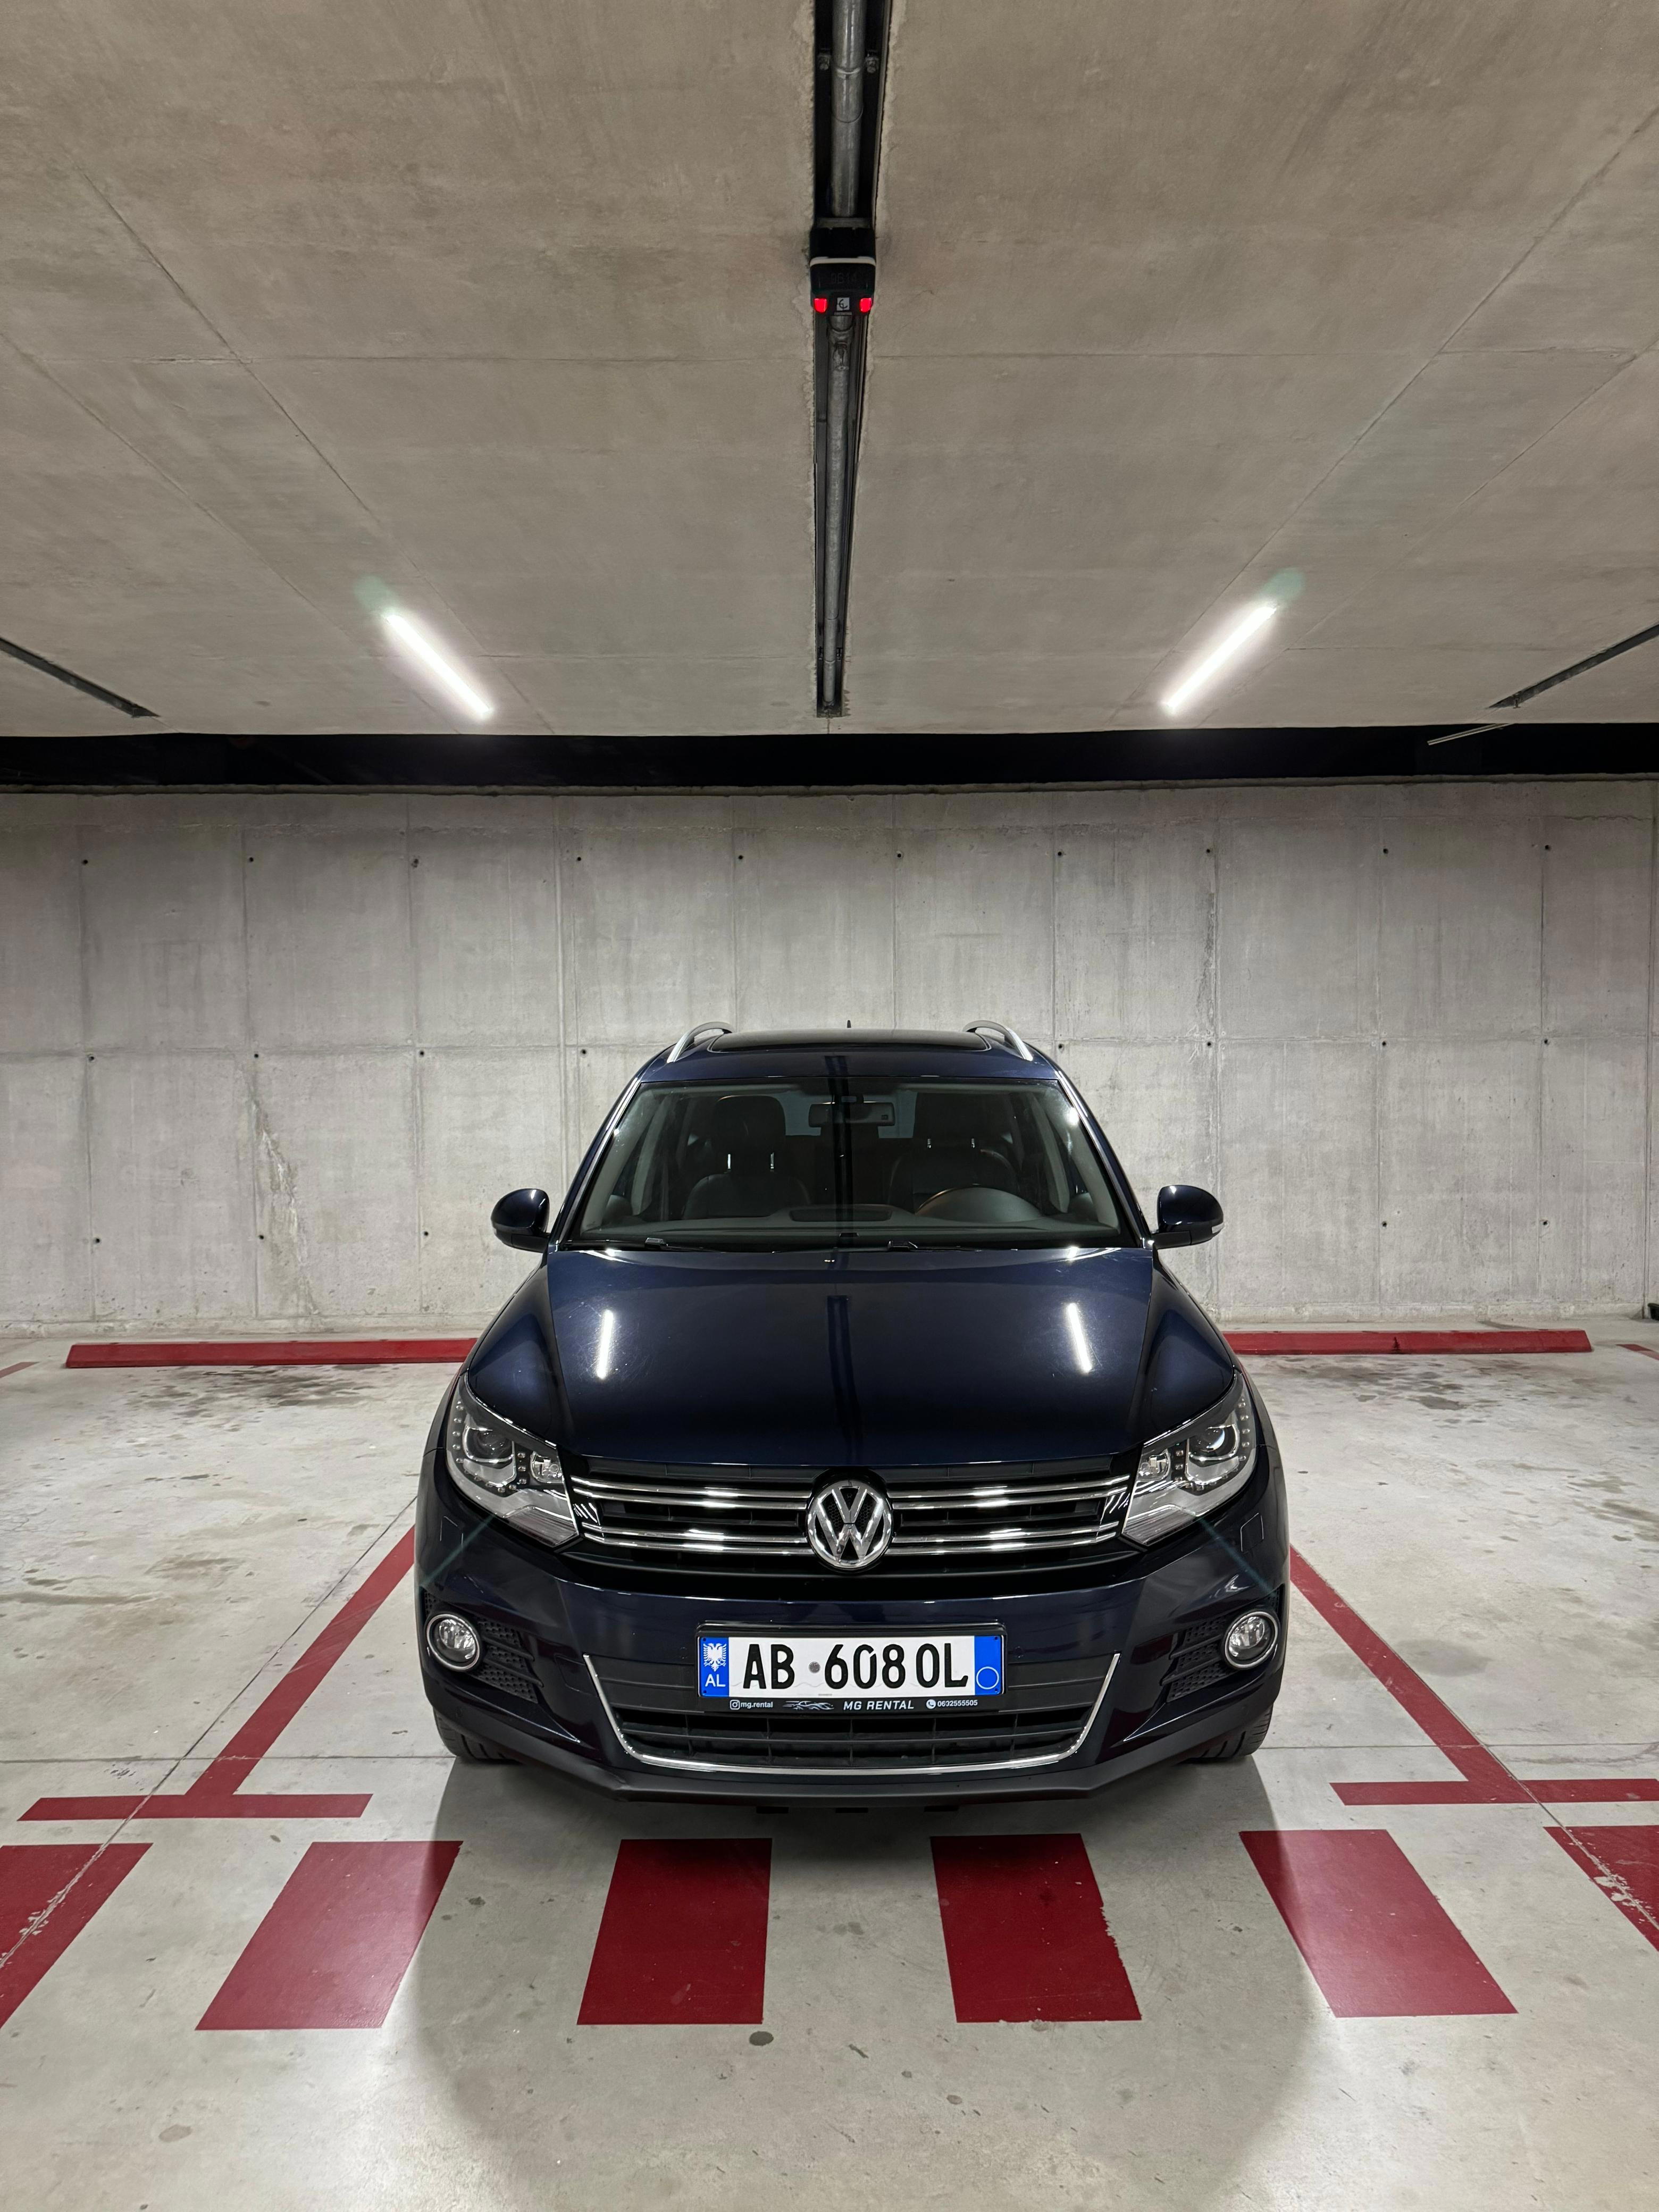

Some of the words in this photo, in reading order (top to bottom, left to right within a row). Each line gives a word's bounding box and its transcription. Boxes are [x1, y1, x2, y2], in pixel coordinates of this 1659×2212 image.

[743, 1644, 795, 1689] AB
[705, 1674, 725, 1687] AL
[843, 1700, 862, 1710] MG
[867, 1700, 914, 1710] RENTAL
